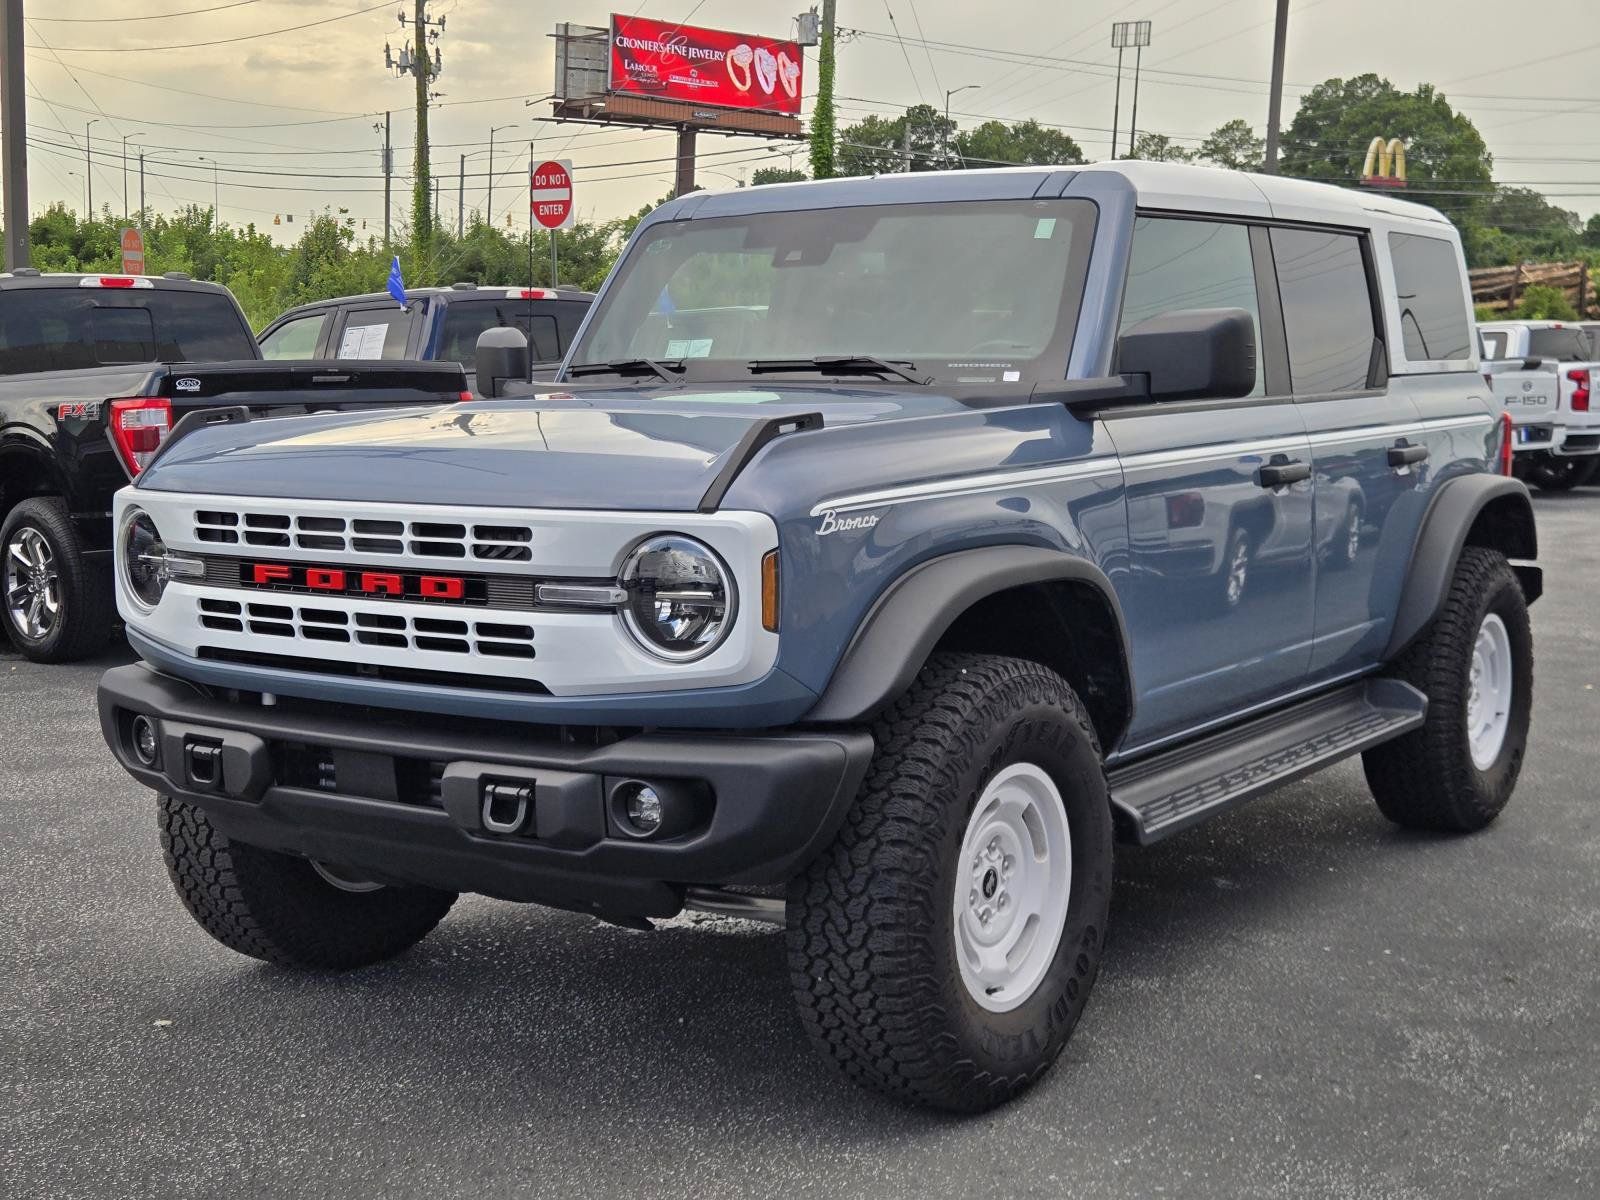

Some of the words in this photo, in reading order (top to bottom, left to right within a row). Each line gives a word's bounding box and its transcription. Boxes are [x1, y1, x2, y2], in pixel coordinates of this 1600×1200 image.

[666, 44, 687, 57] FINE
[689, 47, 726, 61] JEWELRY
[535, 175, 547, 186] DO
[549, 174, 566, 186] NOT
[539, 204, 564, 216] ENTER
[1504, 396, 1548, 406] F-150
[58, 401, 100, 421] FX4
[815, 509, 879, 535] Bronco
[254, 564, 465, 599] FORD
